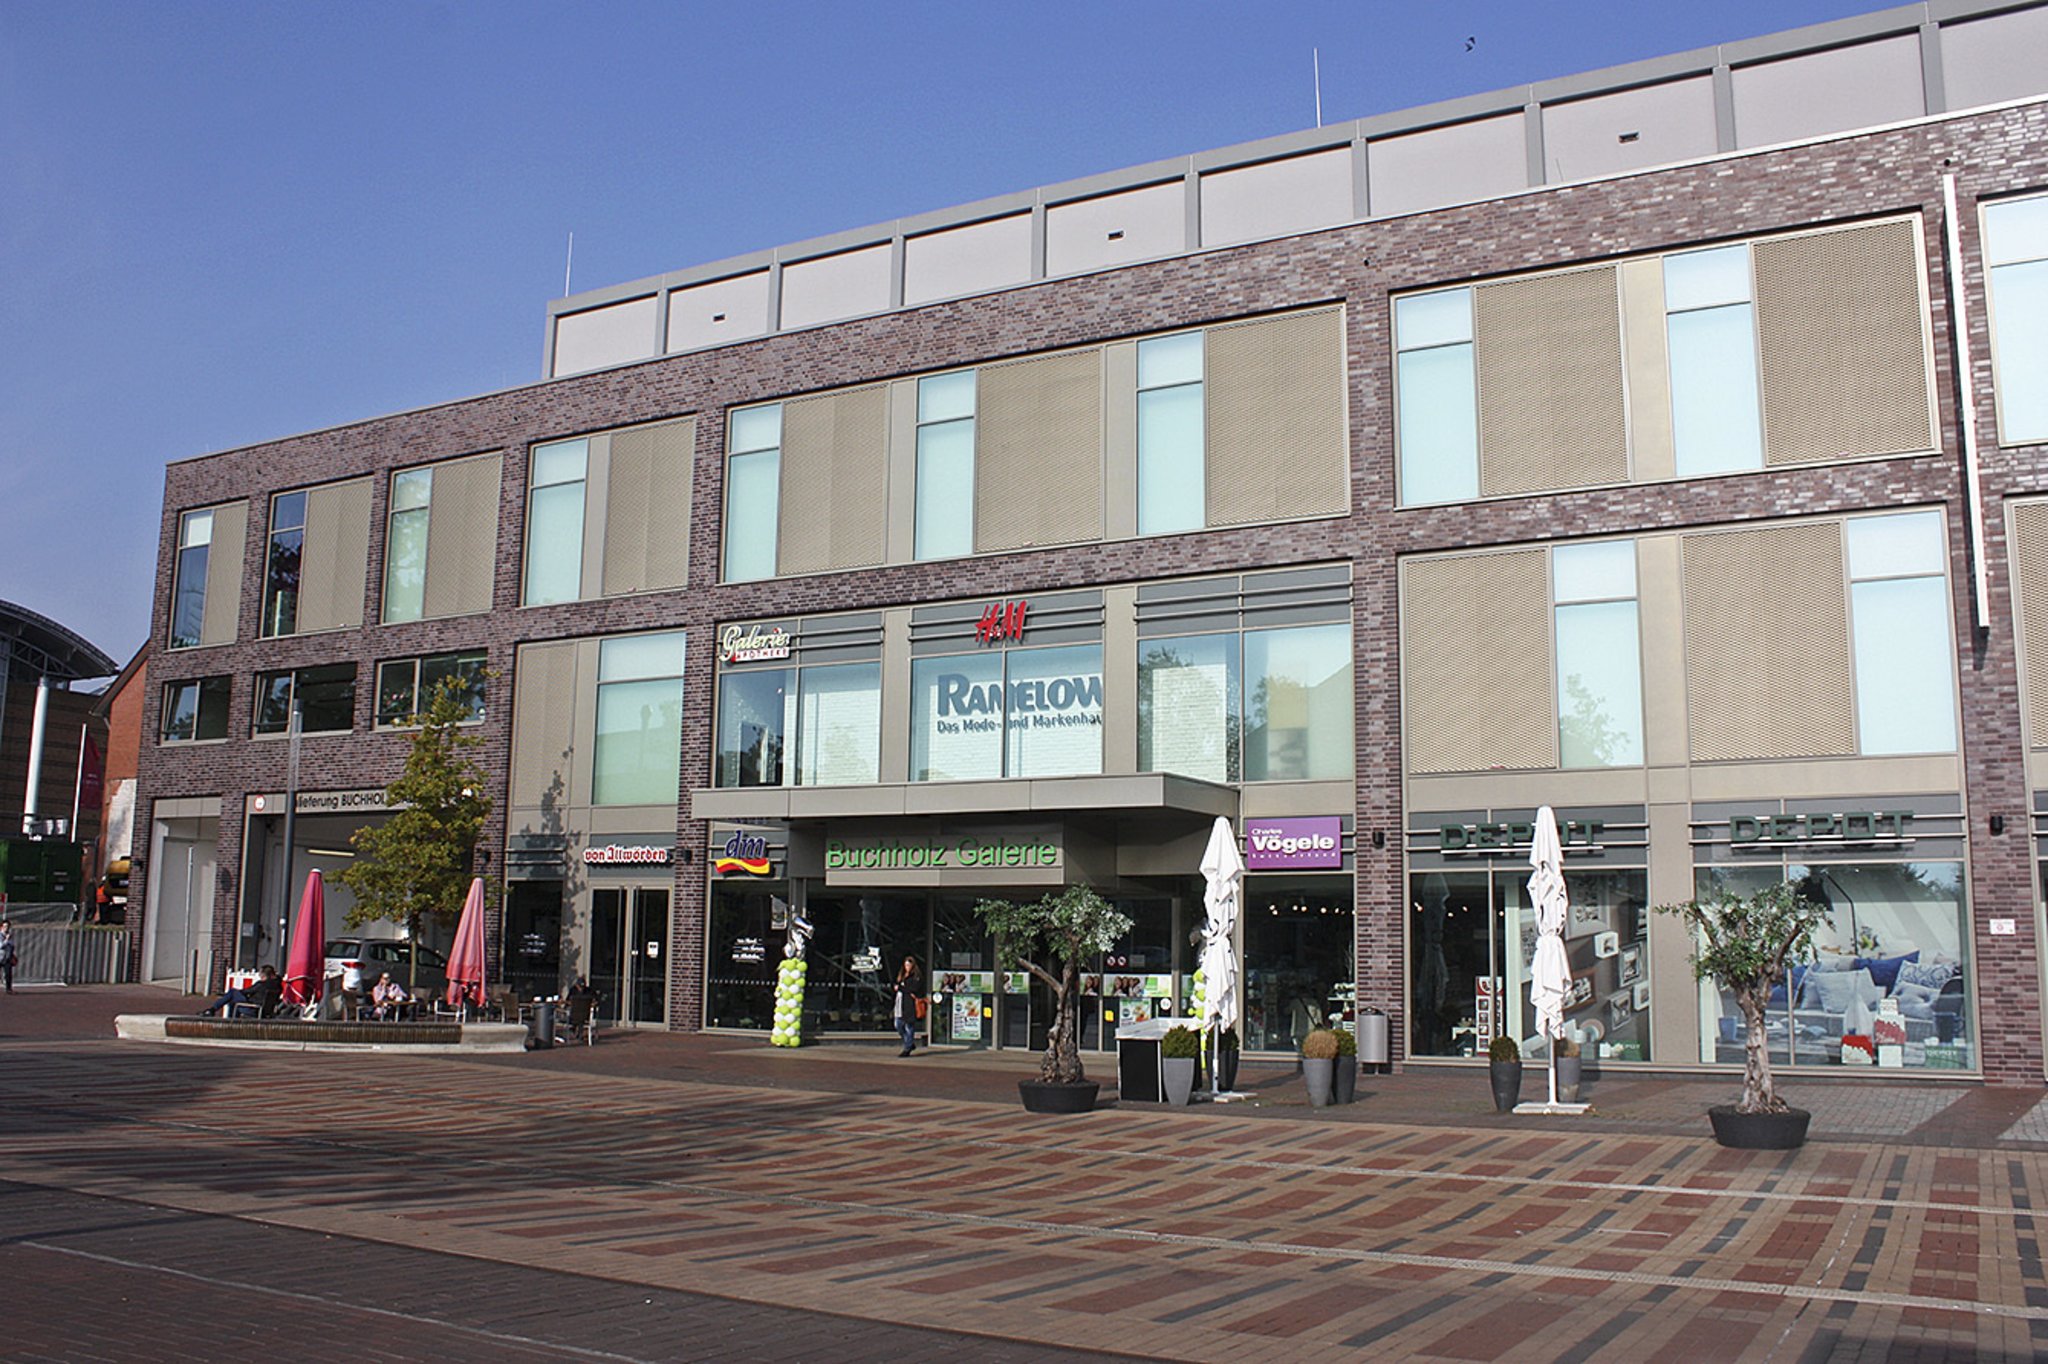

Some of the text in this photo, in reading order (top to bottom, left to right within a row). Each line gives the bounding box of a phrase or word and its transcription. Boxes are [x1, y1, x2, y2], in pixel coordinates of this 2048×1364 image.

[975, 600, 1027, 642] H&M
[735, 647, 788, 660] APOTHEKE
[938, 674, 1102, 717] RAMELOW
[937, 720, 959, 734] Das
[963, 718, 1002, 733] Mode-
[1033, 712, 1102, 729] Markenhau
[341, 792, 386, 806] BUCHHOL
[1730, 810, 1914, 841] DEPOT
[584, 848, 606, 862] von
[726, 829, 766, 858] dm
[827, 836, 1057, 867] Buchholz Galerie
[1251, 833, 1335, 854] Vögele
